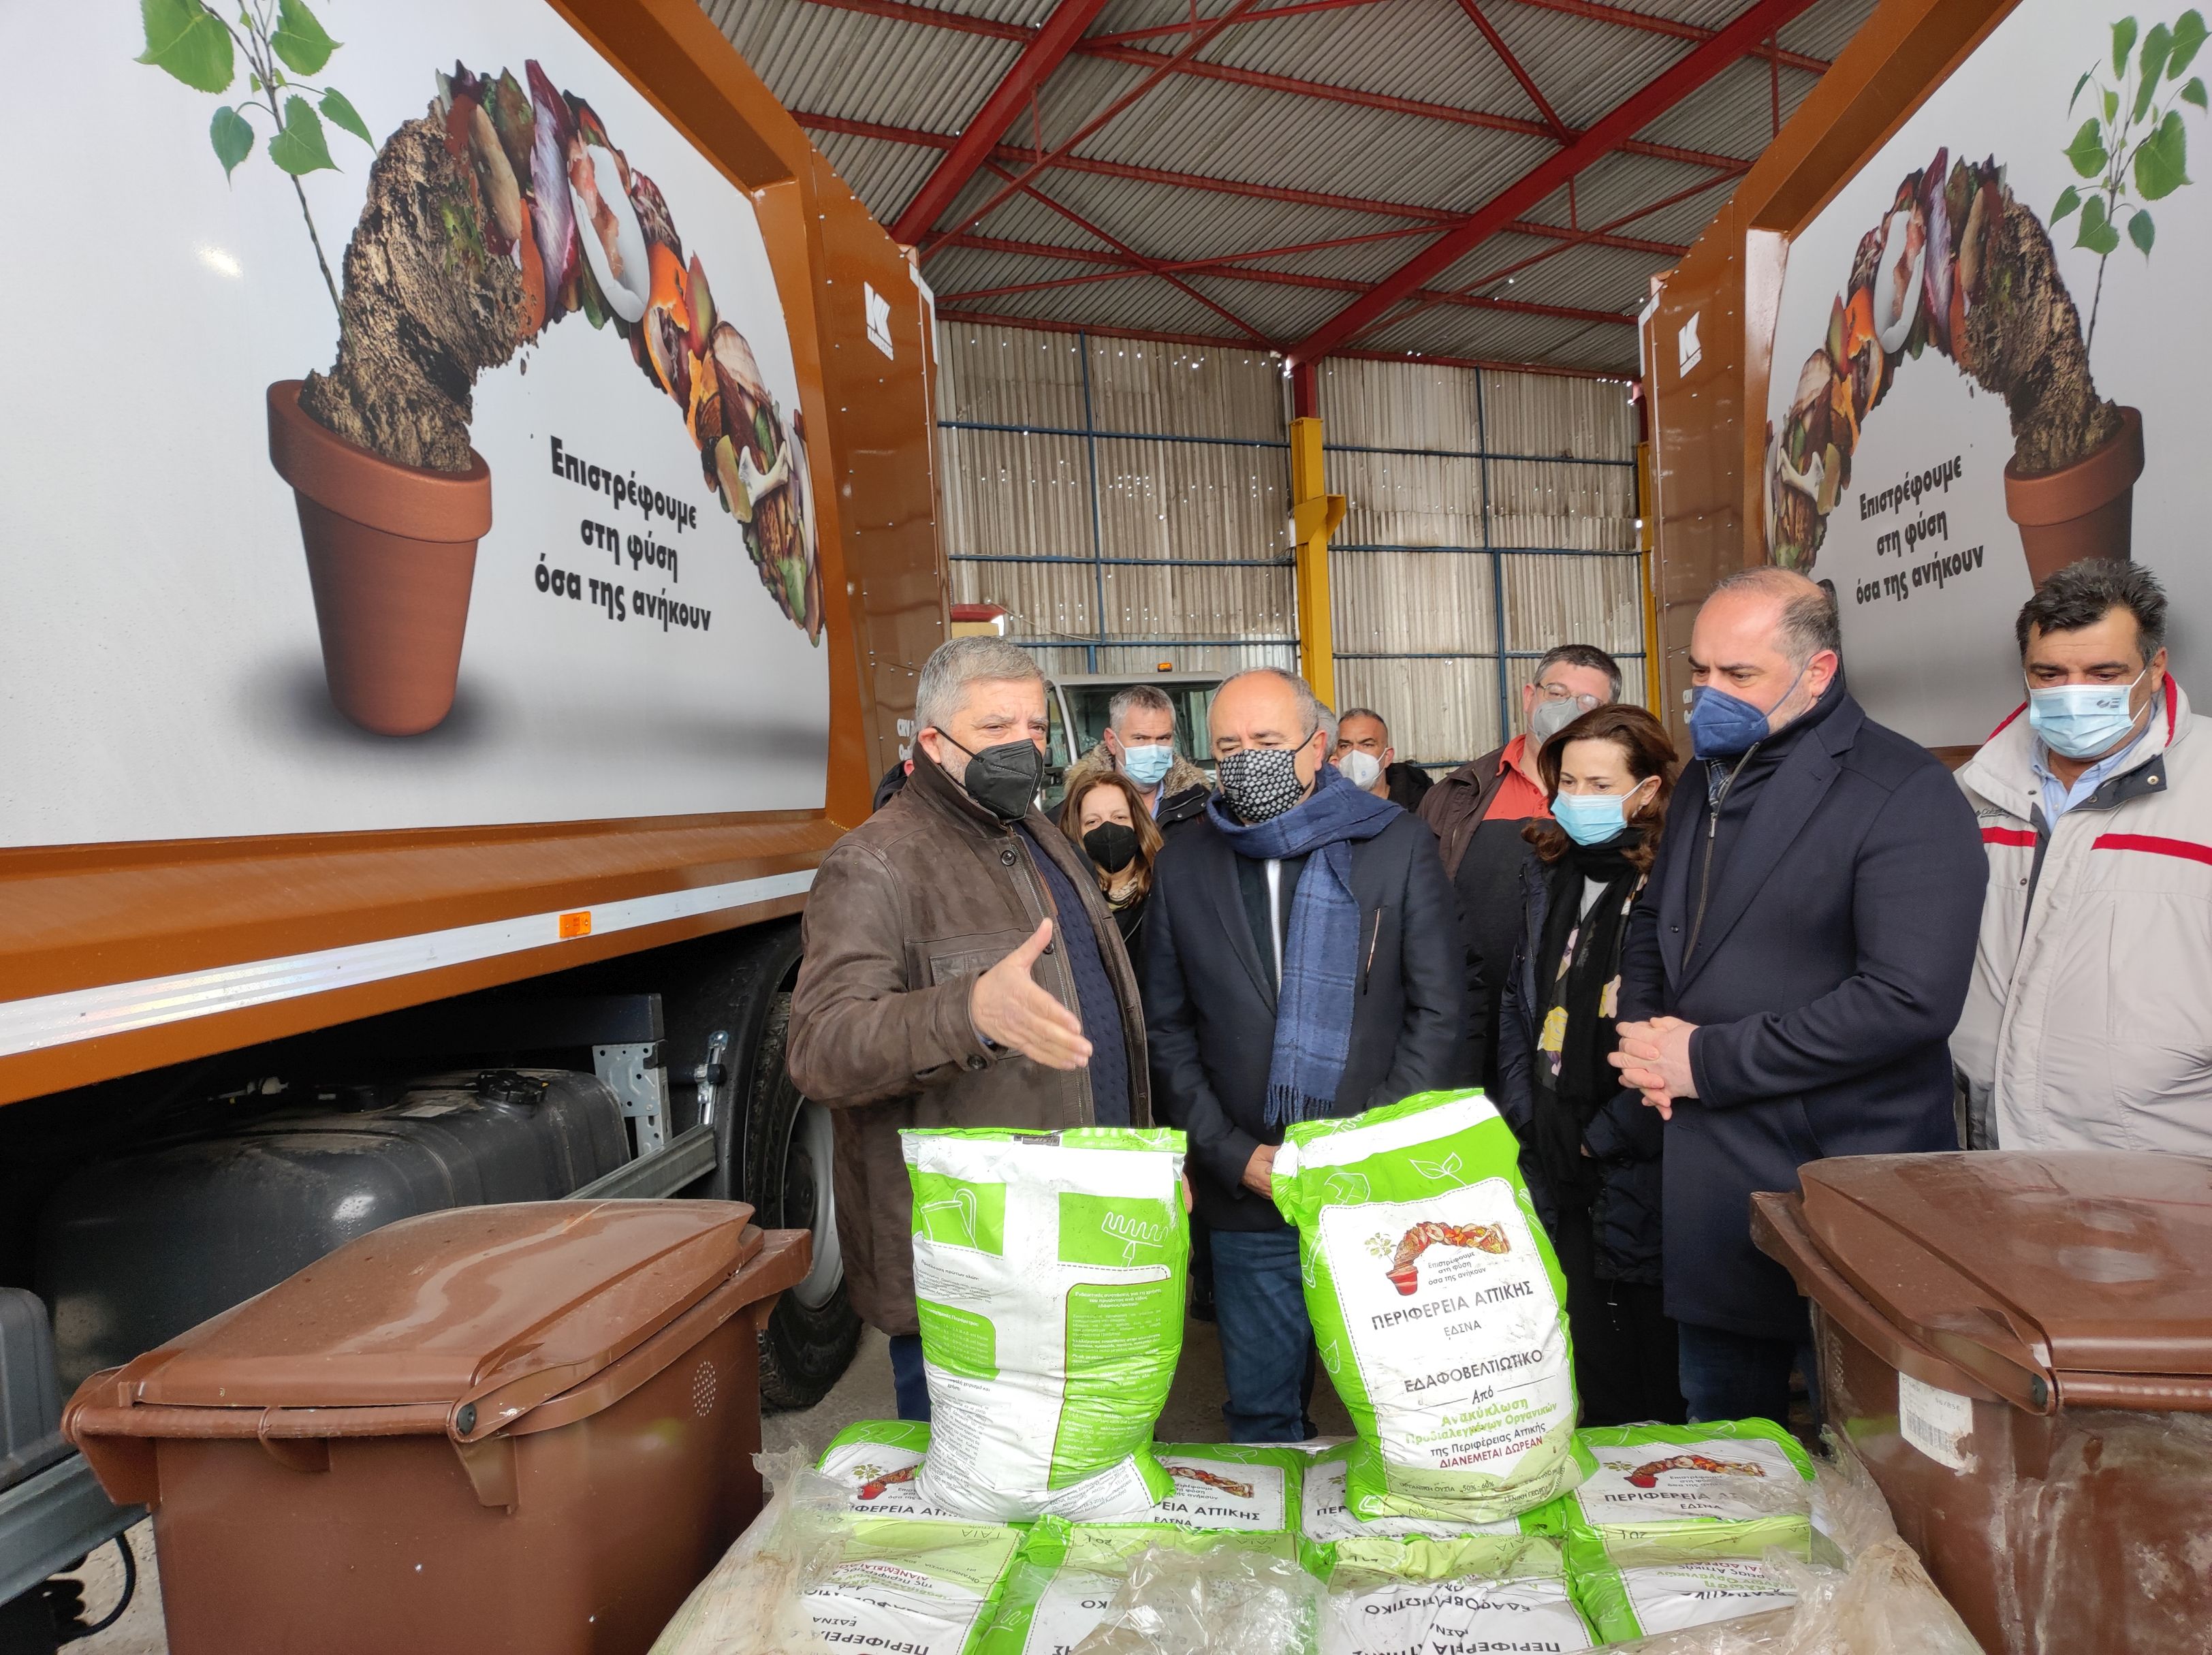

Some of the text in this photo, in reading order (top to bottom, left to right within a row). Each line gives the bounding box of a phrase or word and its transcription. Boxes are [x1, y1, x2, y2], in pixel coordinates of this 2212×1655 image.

[550, 435, 697, 533] Επιστρέφουμε
[1859, 455, 1961, 521] Επιστρέφουμε
[1877, 511, 1948, 557] στη φύση
[581, 520, 677, 583] στη φύση
[535, 552, 711, 632] όσα της ανήκουν
[1856, 546, 1983, 604] όσα της ανήκουν
[1458, 1267, 1486, 1278] ανήκουν
[1371, 1280, 1534, 1330] ΠΕΡΙΦΕΡΕΙΑ ΑΤΤΙΚΗΣ
[1443, 1320, 1482, 1336] ΕΔΣΝΑ
[1404, 1349, 1543, 1393] ΕΔΑΦΟΒΕΛΤΙΩΤΙΚΟ
[1472, 1385, 1494, 1404] Από
[1441, 1398, 1528, 1427] Ανακύκλωση
[1505, 1402, 1558, 1426] Οργανικών
[1431, 1421, 1546, 1457] της Περιφέρειας Αττικής
[1440, 1436, 1543, 1468] ΔΙΑΝΕΜΕΤΑΙ ΔΩΡΕΑΝ
[1195, 1507, 1260, 1521] ΑΤΤΙΚΗΣ
[1605, 1492, 1710, 1502] ΠΕΡΙΦΕΡΕΙΑ
[812, 1616, 857, 1627] ΕΔΣΝΑ
